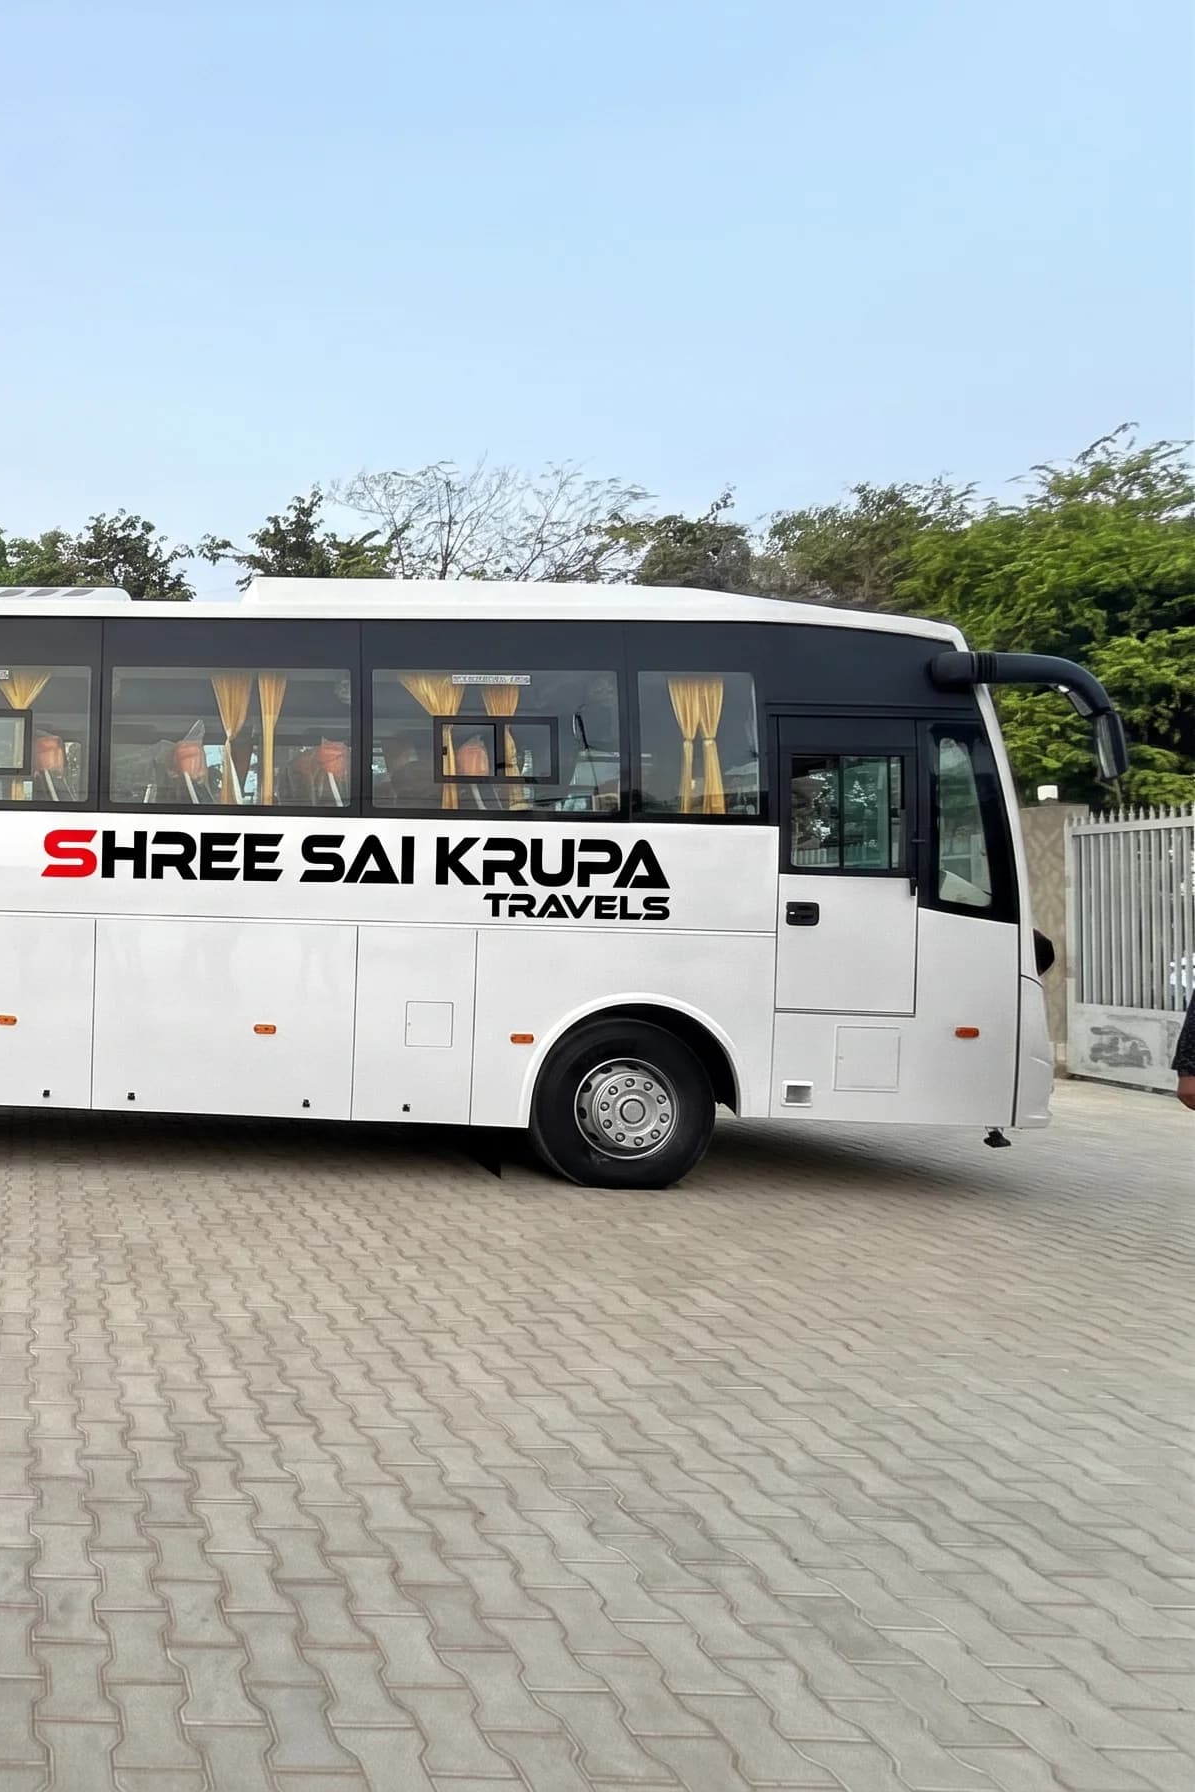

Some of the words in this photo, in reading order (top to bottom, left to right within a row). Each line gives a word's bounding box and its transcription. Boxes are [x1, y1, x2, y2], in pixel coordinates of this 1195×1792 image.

[41, 829, 284, 881] SHREE
[300, 834, 415, 884] SAI
[435, 836, 671, 889] KRUPA
[483, 892, 670, 920] TRAVELS
